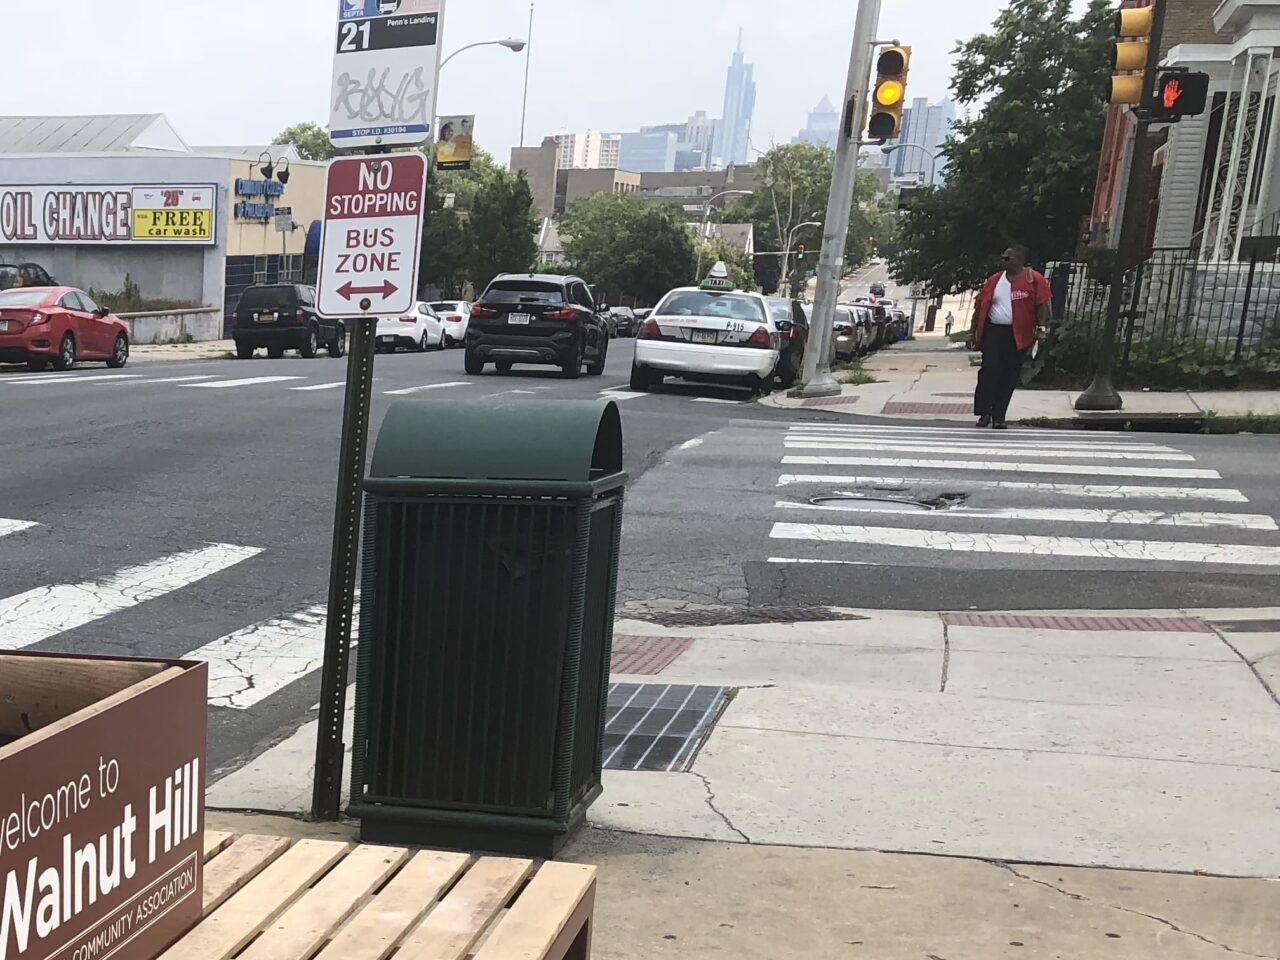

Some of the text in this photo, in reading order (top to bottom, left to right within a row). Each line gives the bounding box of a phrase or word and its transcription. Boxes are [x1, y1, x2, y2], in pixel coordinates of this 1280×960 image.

[343, 9, 364, 18] SEPTA
[410, 16, 435, 24] Landing
[340, 21, 371, 51] 21
[358, 160, 393, 191] NO
[330, 191, 417, 215] STOPPING
[1, 191, 37, 240] OIL
[43, 191, 131, 240] CHANGE
[152, 212, 203, 226] FREE
[173, 226, 206, 235] wash
[346, 228, 394, 248] BUS
[335, 252, 401, 273] ZONE
[726, 321, 744, 331] P-915
[98, 756, 120, 798] to
[148, 757, 199, 865] Hill
[135, 866, 194, 925] ASSOCIATION
